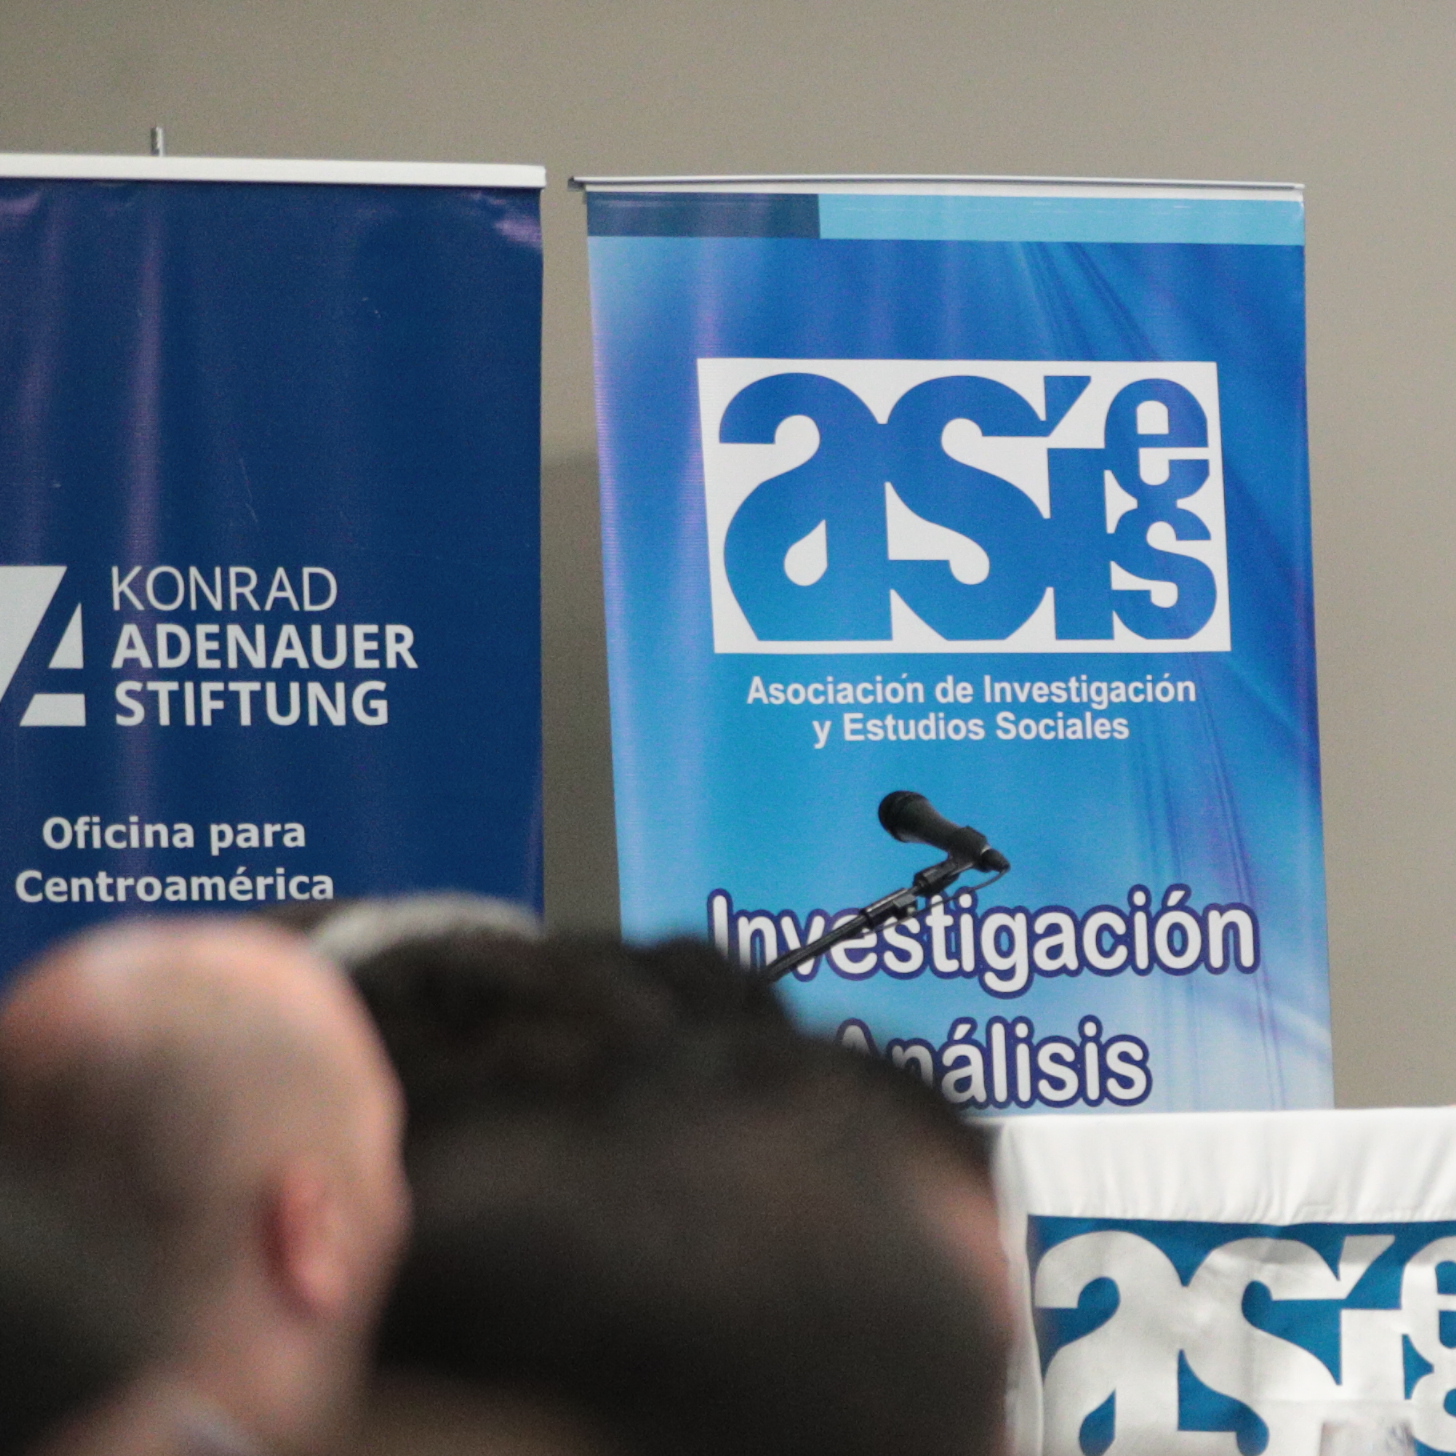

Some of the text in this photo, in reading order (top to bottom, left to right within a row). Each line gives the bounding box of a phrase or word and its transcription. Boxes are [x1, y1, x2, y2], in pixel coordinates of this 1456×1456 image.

[111, 565, 338, 612] KONRAD
[111, 623, 418, 669] ADENAUER
[115, 680, 389, 727] STIFTUNG
[747, 673, 1197, 709] Asociación de Investigación
[812, 711, 1130, 749] y Estudios Sociales
[42, 815, 306, 856] Oficina para
[15, 866, 334, 902] Centroamérica
[708, 886, 1258, 996] Investigación
